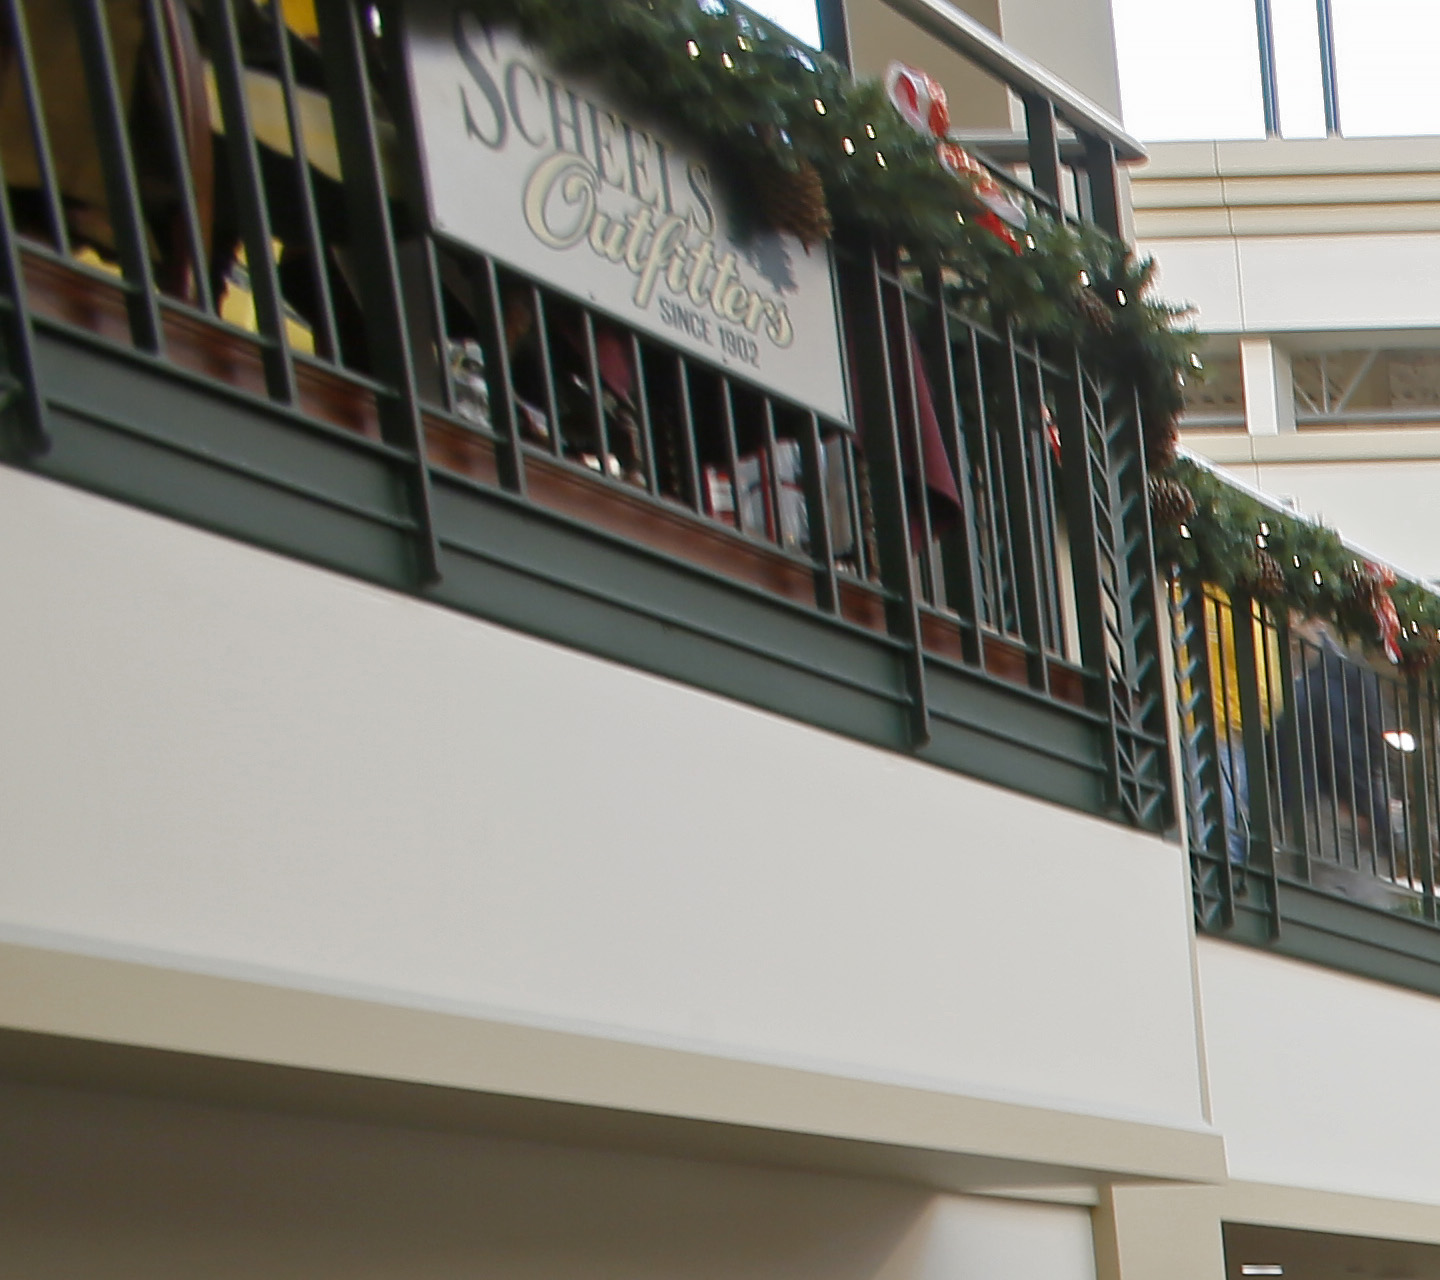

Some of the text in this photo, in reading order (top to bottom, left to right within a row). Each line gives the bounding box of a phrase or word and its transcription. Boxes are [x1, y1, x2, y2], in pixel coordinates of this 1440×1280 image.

[522, 150, 794, 348] Outfitters
[658, 297, 762, 370] SINCE 1902
